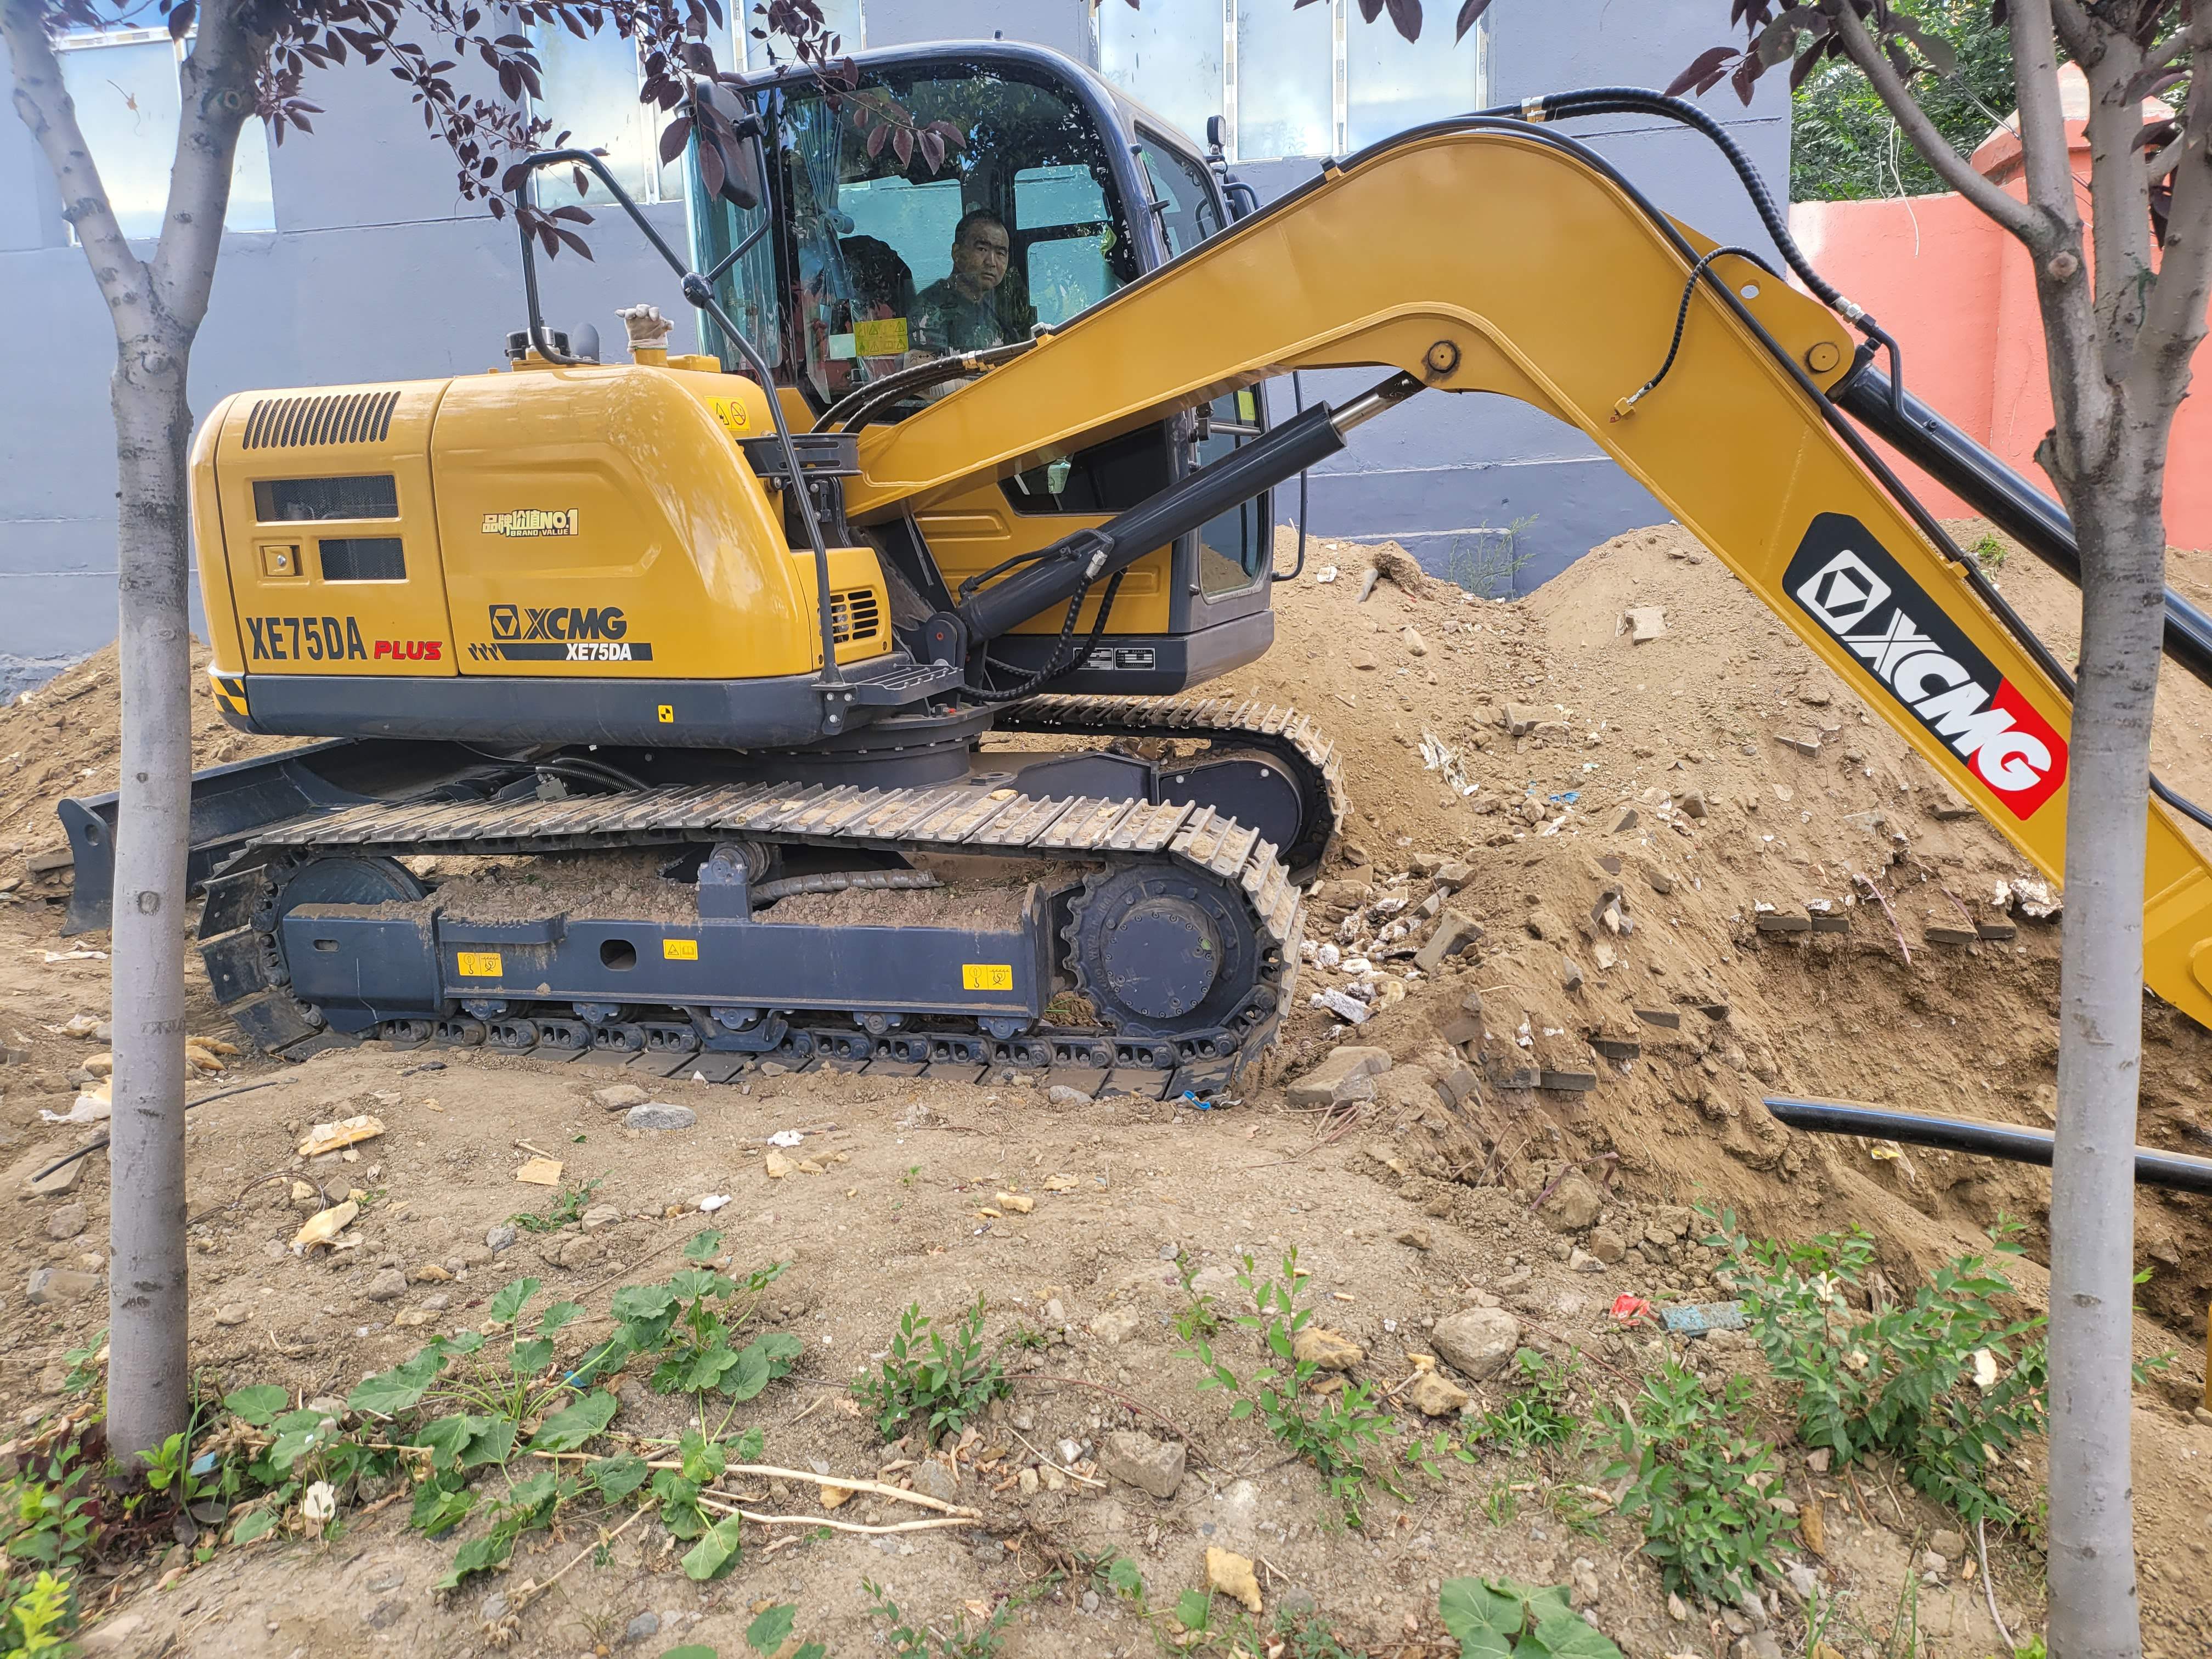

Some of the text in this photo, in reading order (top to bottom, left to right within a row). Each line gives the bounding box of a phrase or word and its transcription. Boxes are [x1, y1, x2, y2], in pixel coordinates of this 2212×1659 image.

[246, 616, 442, 660] XE75DA PLUS
[522, 607, 627, 640] XCMG
[566, 643, 632, 661] XE75DA
[1841, 607, 2051, 791] XCMG
